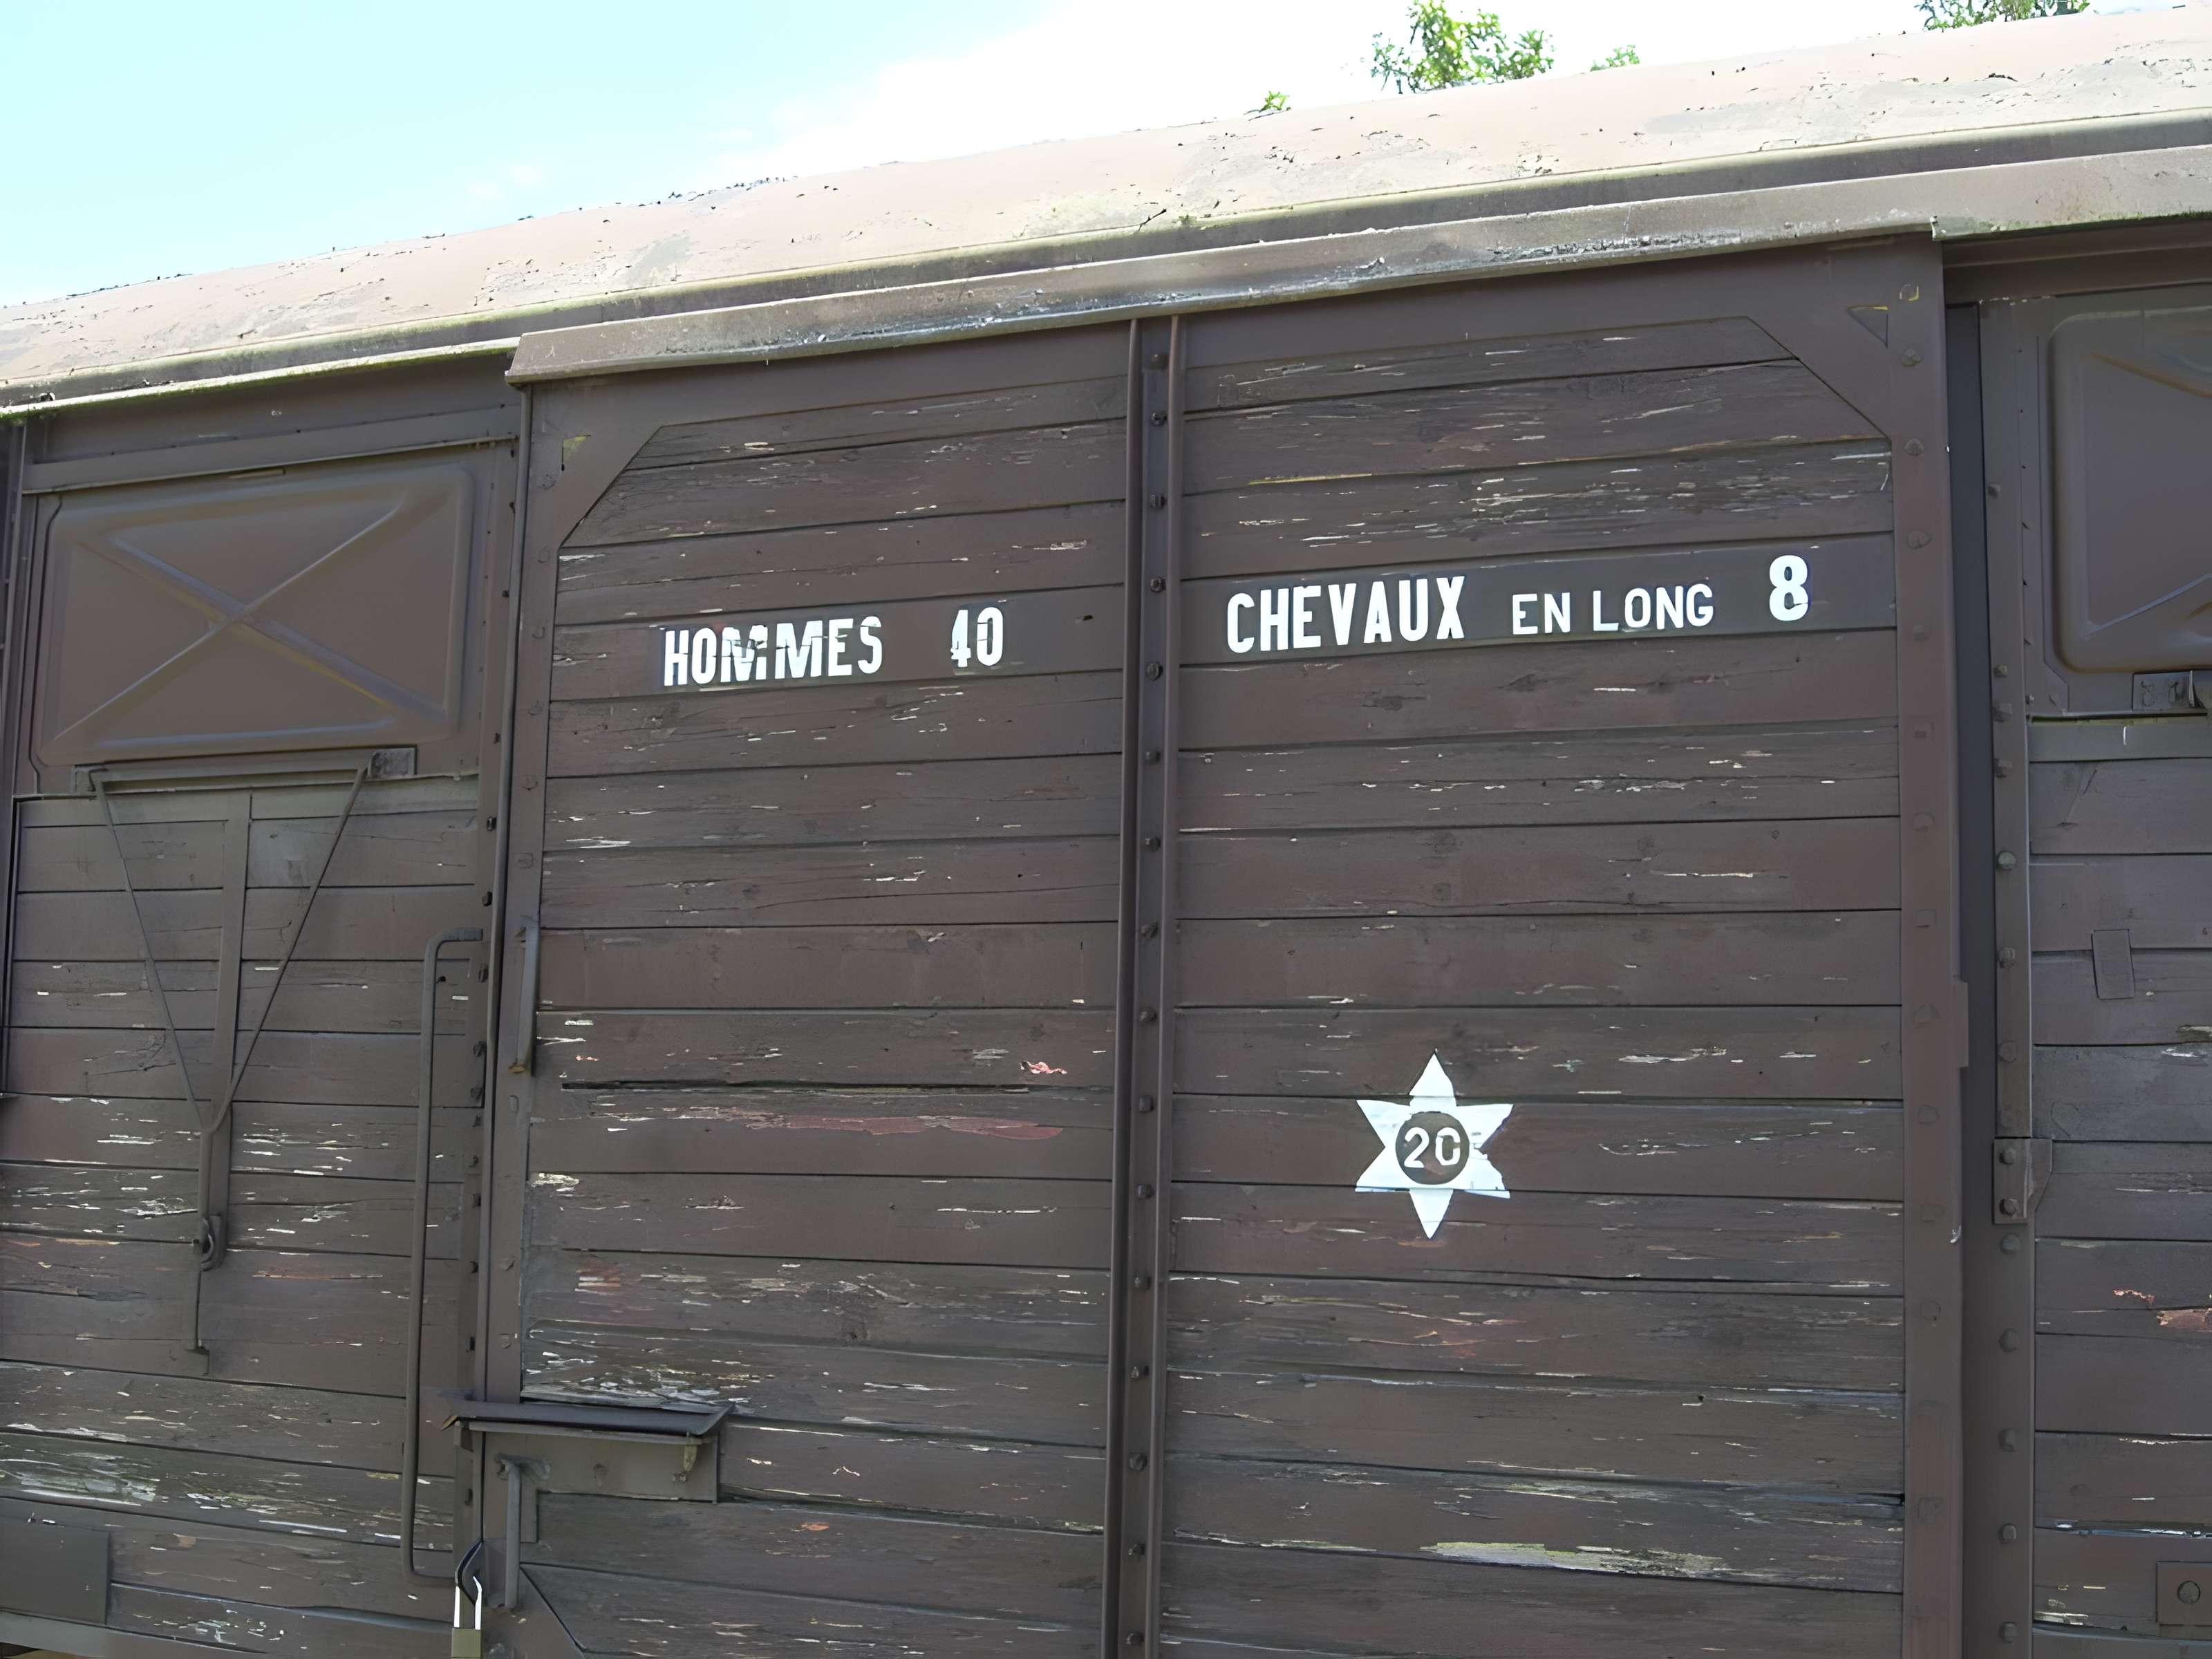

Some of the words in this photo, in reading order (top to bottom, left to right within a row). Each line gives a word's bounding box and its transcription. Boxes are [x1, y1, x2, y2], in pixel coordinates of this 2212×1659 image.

[664, 616, 883, 686] HOMMES
[950, 606, 1004, 668] 40
[1227, 575, 1465, 654] CHEVAUX
[1512, 592, 1571, 635] EN
[1593, 583, 1714, 632] LONG
[1769, 555, 1808, 621] 8
